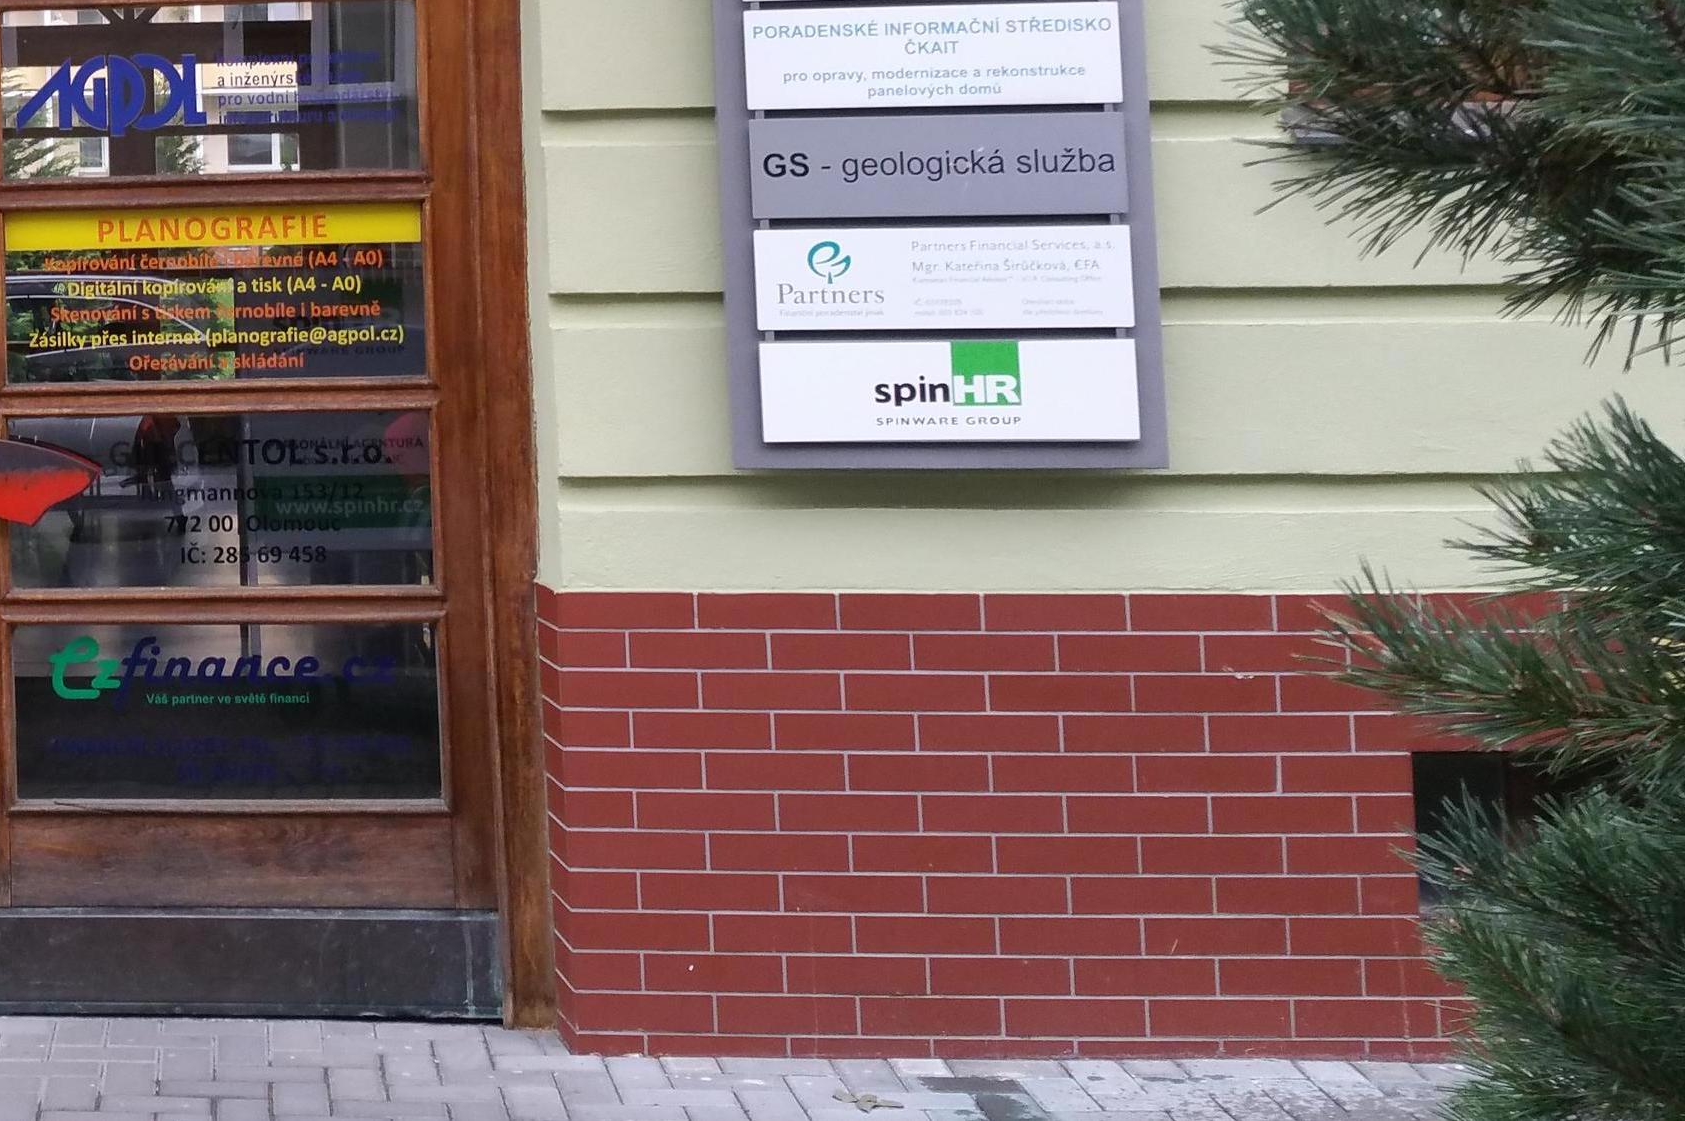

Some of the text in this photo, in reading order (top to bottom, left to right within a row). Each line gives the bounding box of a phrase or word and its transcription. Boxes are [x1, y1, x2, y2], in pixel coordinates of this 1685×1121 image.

[753, 15, 1111, 40] PORADENSKÉ INFORMAČNÍ STŘEDISKO
[904, 39, 959, 55] ČKAIT
[217, 75, 225, 87] a
[783, 64, 1085, 84] pro opravy, modernizace a rekonstrukce
[218, 94, 242, 109] pro
[867, 83, 1002, 99] panelových domů
[762, 147, 1116, 183] GS geologická služba
[98, 213, 327, 242] PLANOGRAFIE
[911, 240, 967, 252] Partners
[971, 239, 1027, 251] Financial
[45, 252, 135, 274] Kopírování
[309, 250, 337, 268] (A4
[354, 249, 383, 268] A0)
[67, 274, 361, 299] Digitální kopírování a tisk (A4 A0)
[777, 282, 885, 306] Partners
[50, 300, 381, 321] Skenování s tiskem barevně
[29, 324, 405, 349] Zásilky přes internet (planografie@agpol.cz)
[129, 353, 305, 371] Ořezávání skládání
[875, 373, 1021, 406] spinHR
[876, 415, 1022, 427] SPINWARE GROUP
[275, 495, 424, 517] www.spinhr.cz
[209, 515, 233, 532] 00
[247, 514, 339, 532] Olomouc
[181, 543, 326, 564] IČ: 69 458
[172, 693, 230, 706] partner ve
